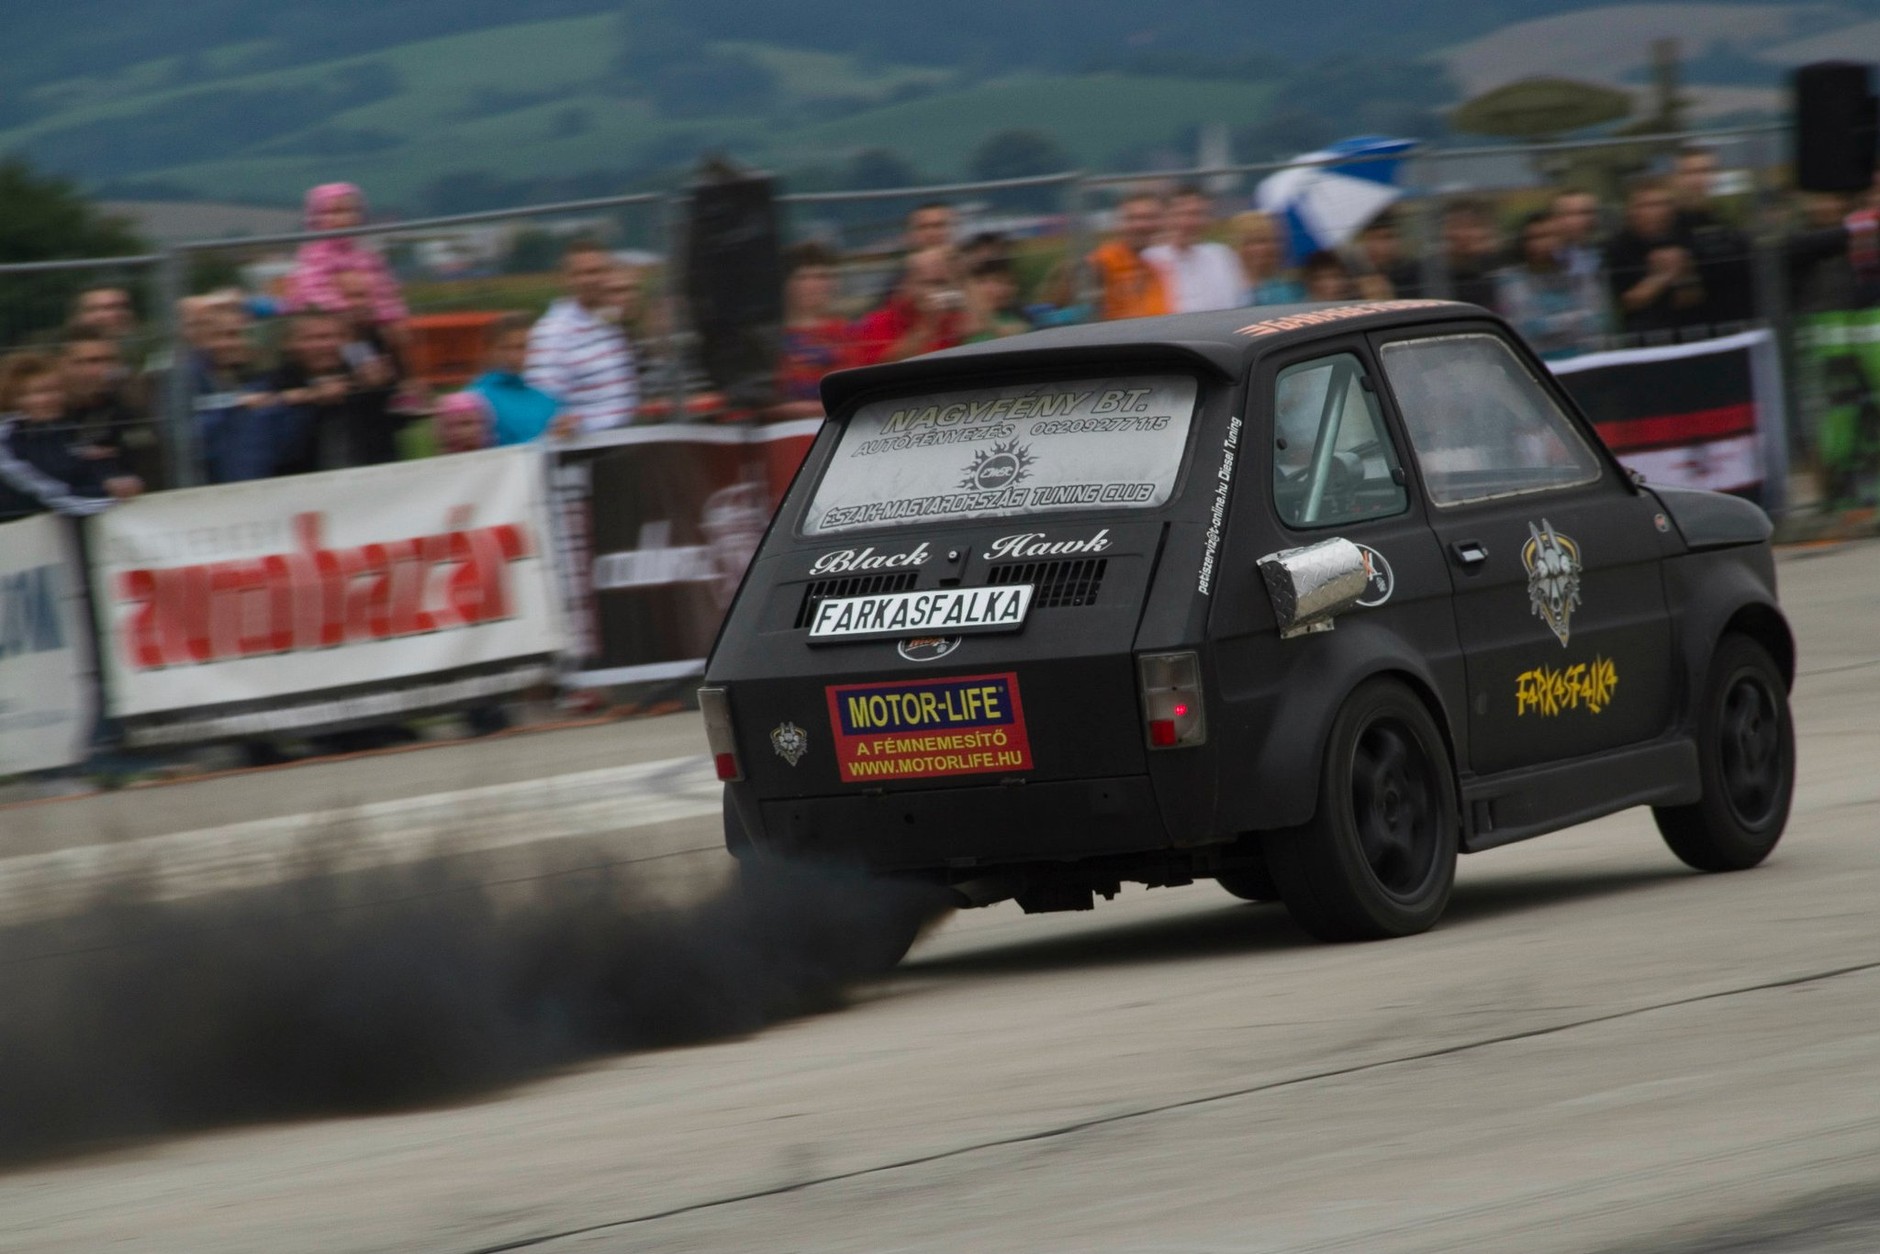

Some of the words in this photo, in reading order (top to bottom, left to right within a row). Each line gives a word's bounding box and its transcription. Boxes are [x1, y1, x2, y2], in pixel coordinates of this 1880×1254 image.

[880, 390, 1094, 435] NAGYFÉNY
[1091, 388, 1151, 415] BT.
[1224, 416, 1242, 449] Tuning
[851, 421, 1015, 457] AUTÓFÉNYEZÉS
[1030, 416, 1171, 436] 06209277115
[1218, 449, 1235, 484] Diesel
[820, 487, 1031, 530] ÉSZAK-MAGYARORSZÁGI
[1030, 485, 1102, 507] TUNING
[1099, 483, 1155, 503] CLUB
[809, 542, 932, 576] Black
[983, 529, 1112, 560] Hawk
[1198, 482, 1228, 596] petiszerviz@t-online.hu
[814, 589, 1022, 634] FARKASFALKA
[848, 686, 1001, 729] MOTOR-LIFE
[848, 750, 1023, 777] WWW.MOTORLIFE.HU
[856, 742, 870, 756] A
[873, 729, 1008, 756] FÉMNEMESÍTŐ
